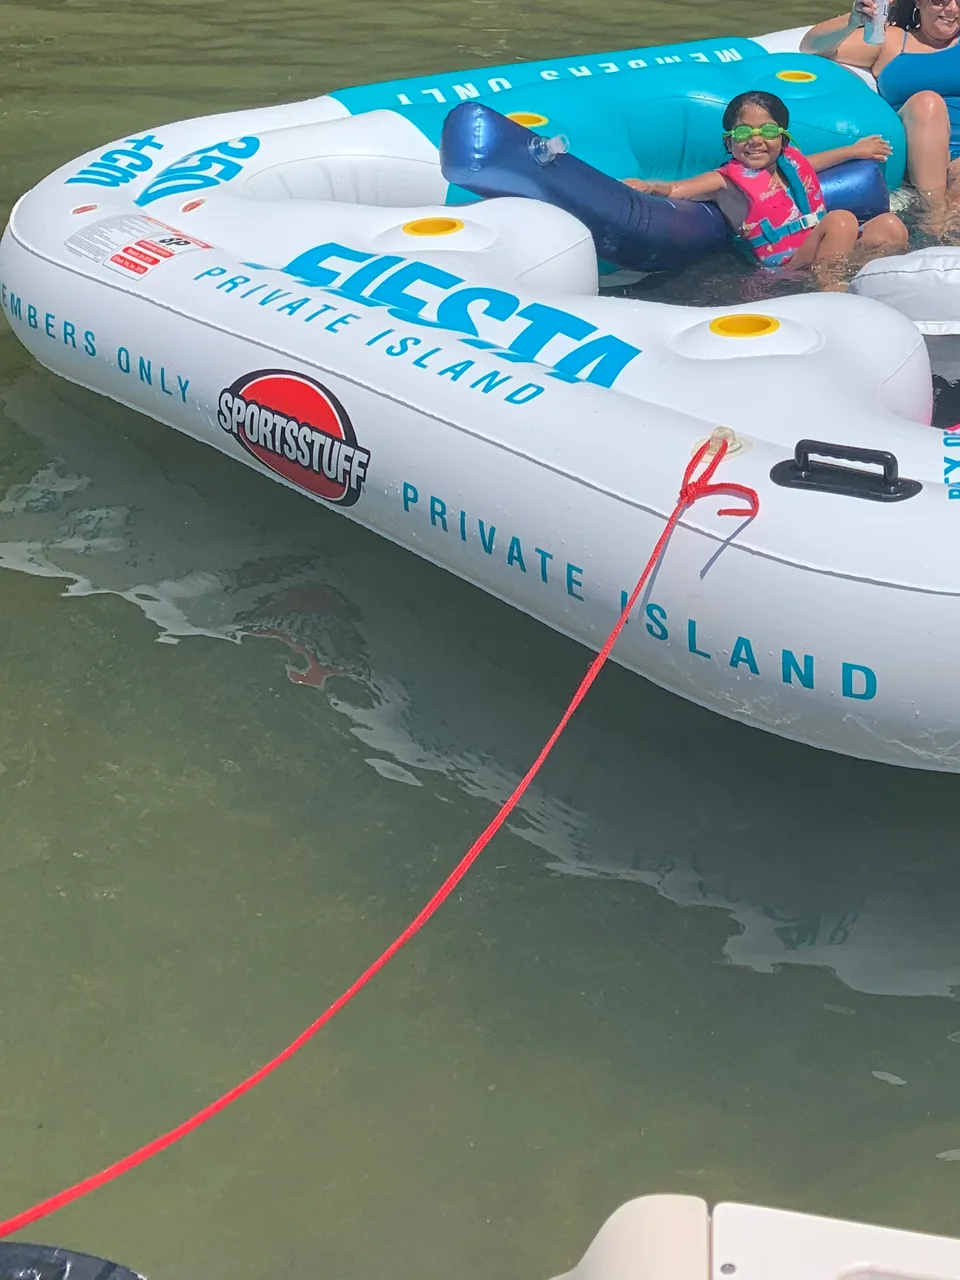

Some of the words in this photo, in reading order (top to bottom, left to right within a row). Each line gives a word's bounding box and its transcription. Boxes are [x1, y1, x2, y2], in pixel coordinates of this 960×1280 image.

[1, 283, 97, 358] EMBERS
[117, 346, 190, 404] ONLY
[193, 266, 361, 334] PRIVATE
[365, 327, 546, 405] ISLAND
[240, 242, 643, 388] FIESTA
[219, 392, 370, 490] SPORTSSTUFF
[402, 481, 585, 602] PRIVATE
[620, 589, 877, 701] ISLAND
